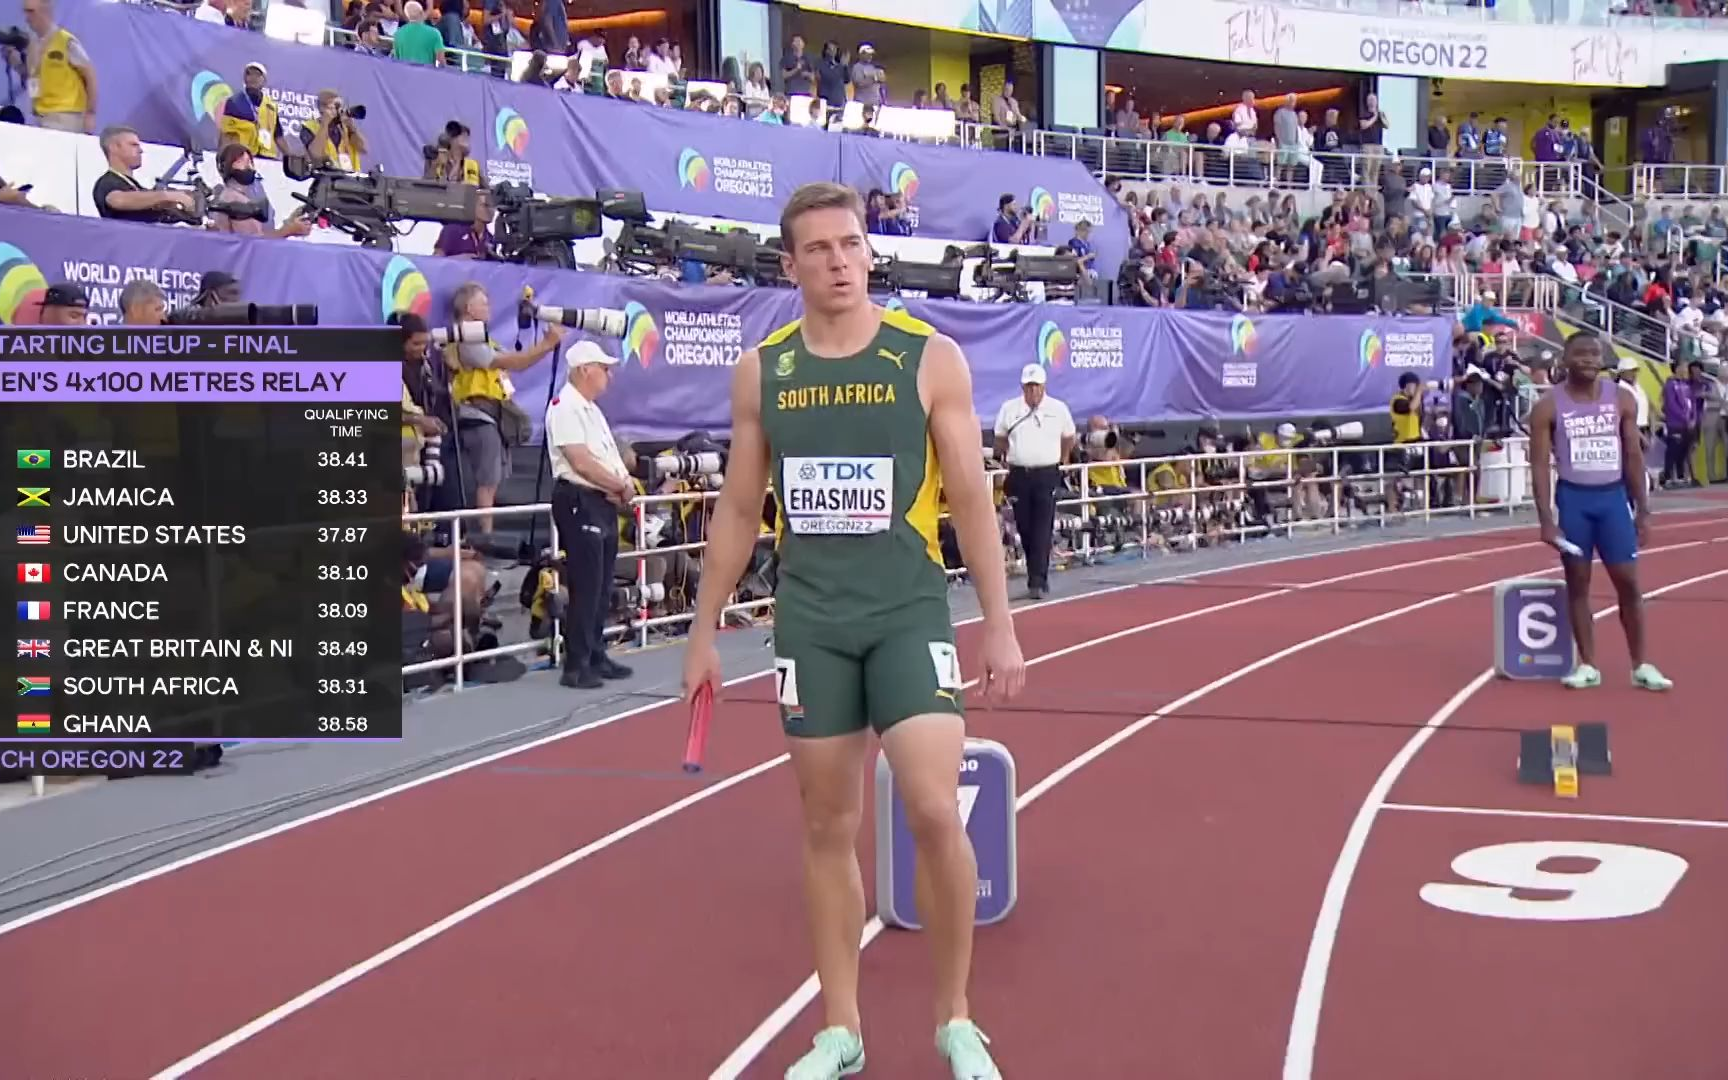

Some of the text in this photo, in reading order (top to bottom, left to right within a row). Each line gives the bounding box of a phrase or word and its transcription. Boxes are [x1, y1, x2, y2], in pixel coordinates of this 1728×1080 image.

[64, 262, 201, 288] WORLD ATHLETICS
[665, 311, 741, 328] WORLD ATHLETICS
[664, 326, 742, 343] CHAMPIONSHIPS
[777, 383, 896, 410] SOUTH AFRICA
[1564, 414, 1616, 428] GREAT
[816, 463, 875, 480] TDK
[789, 488, 886, 511] ERASMUS
[1518, 602, 1558, 649] 6
